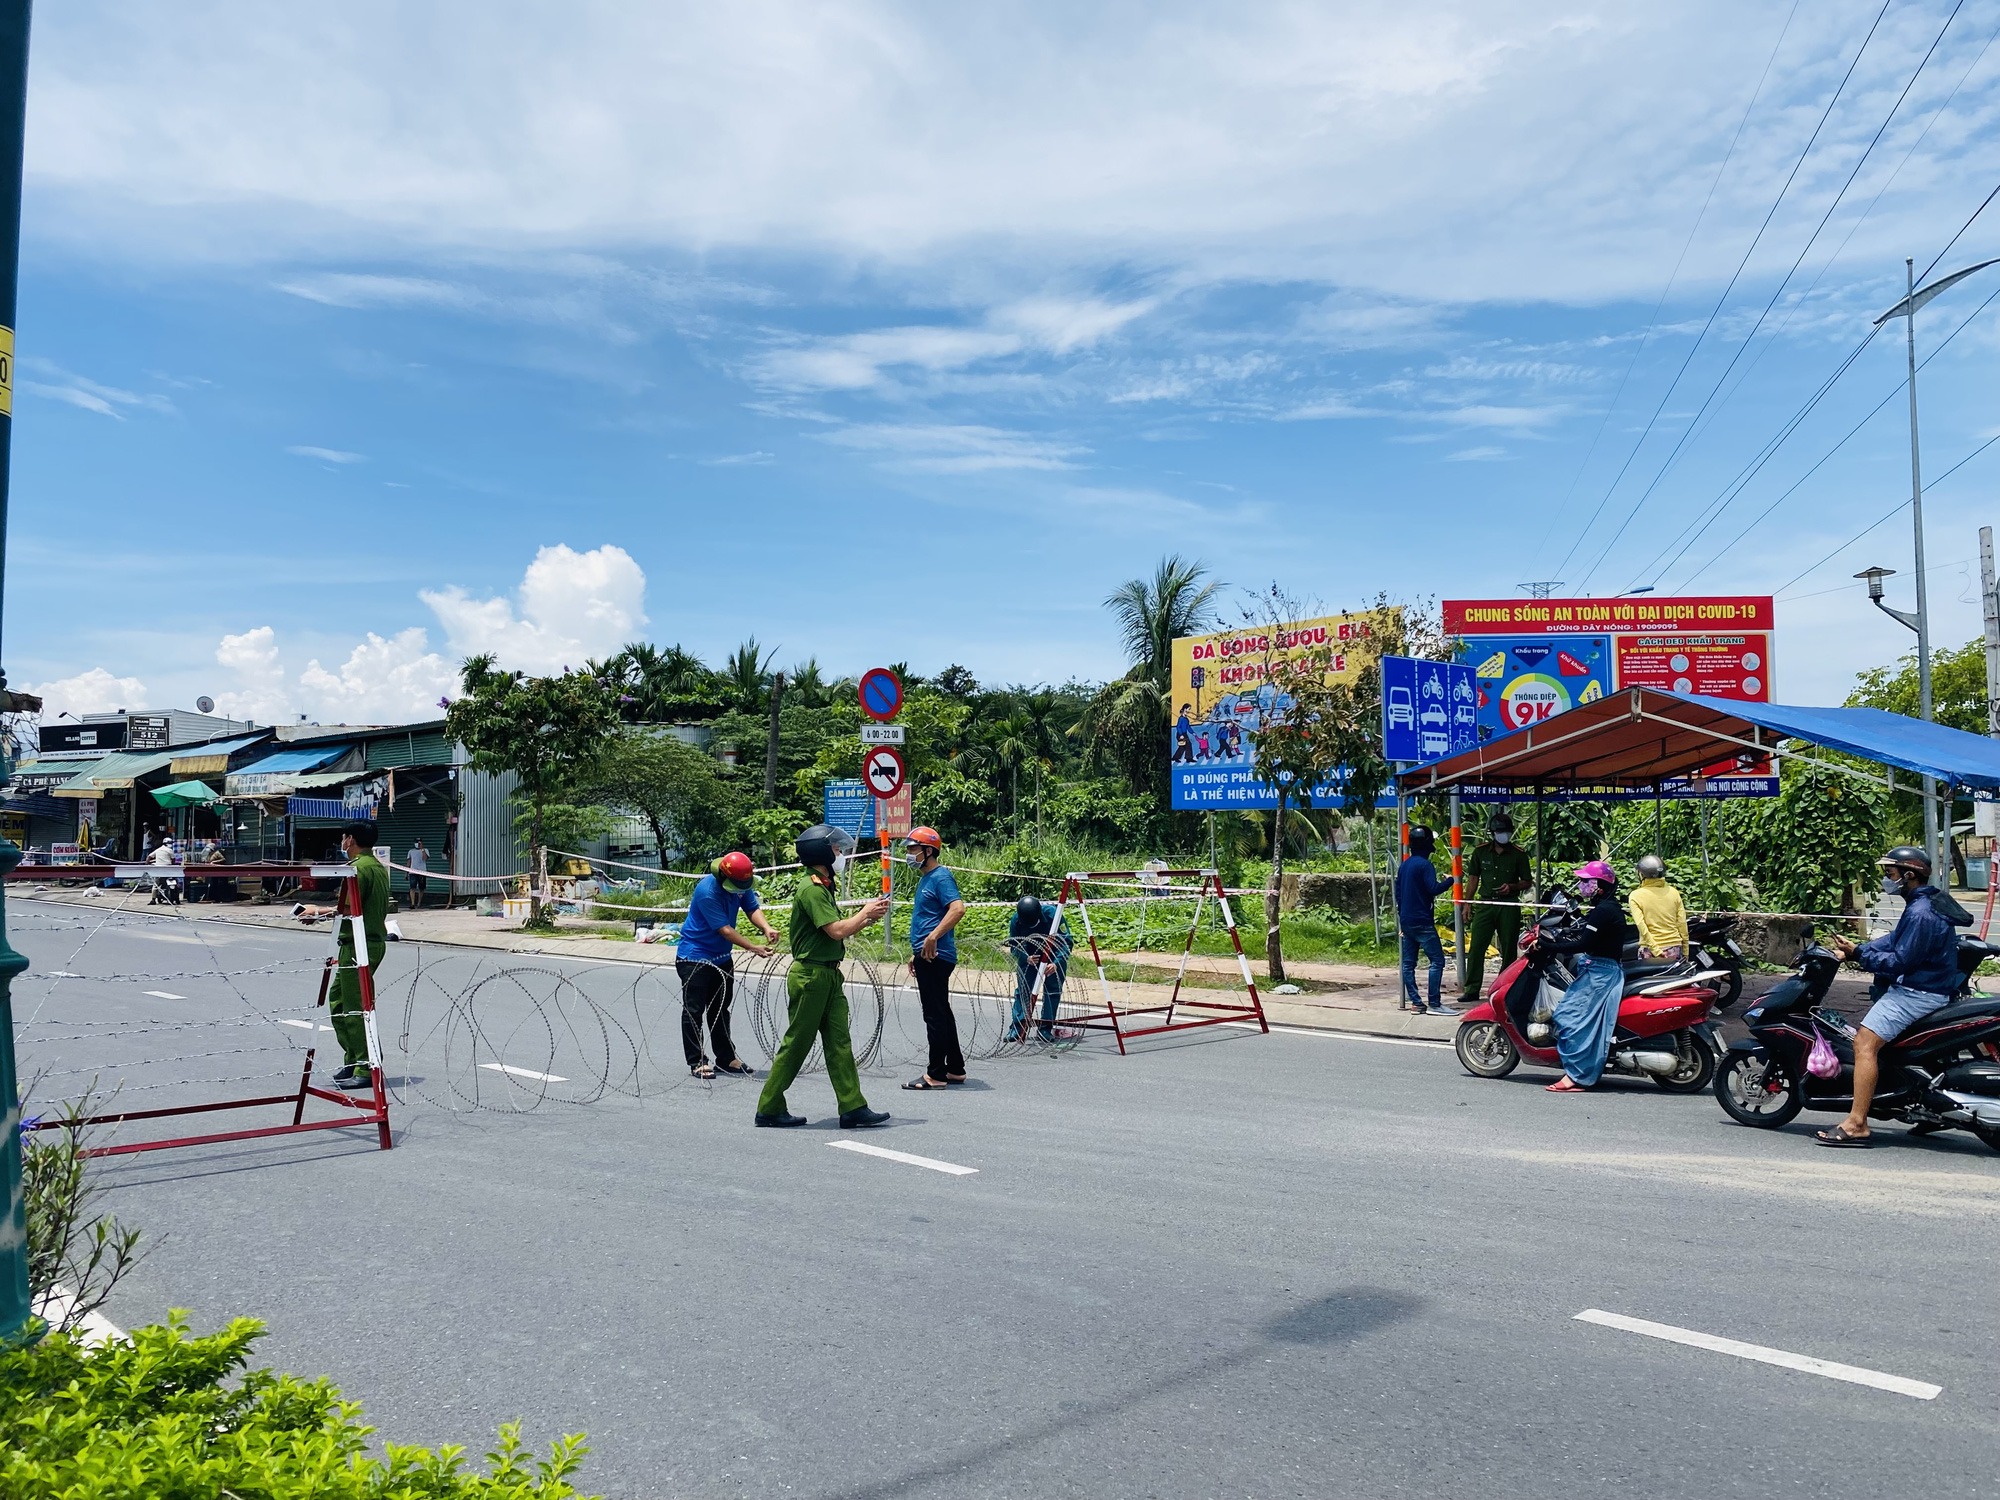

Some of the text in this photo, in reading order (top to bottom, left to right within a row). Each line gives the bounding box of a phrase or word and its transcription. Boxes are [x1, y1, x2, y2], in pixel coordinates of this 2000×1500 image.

[1465, 603, 1756, 622] CHUNG SỐNG AN TOÀN VỚI ĐẠI DỊCH COVID-19
[1540, 693, 1557, 702] ĐIỆP
[1515, 702, 1555, 725] 9K
[1183, 775, 1194, 784] ĐI
[1198, 772, 1228, 784] ĐÚNG
[1731, 779, 1750, 791] CÔNG
[1750, 779, 1768, 792] CỘNG
[1184, 788, 1198, 800] LÀ
[1201, 785, 1224, 800] THỂ
[1227, 787, 1255, 801] HIỆN
